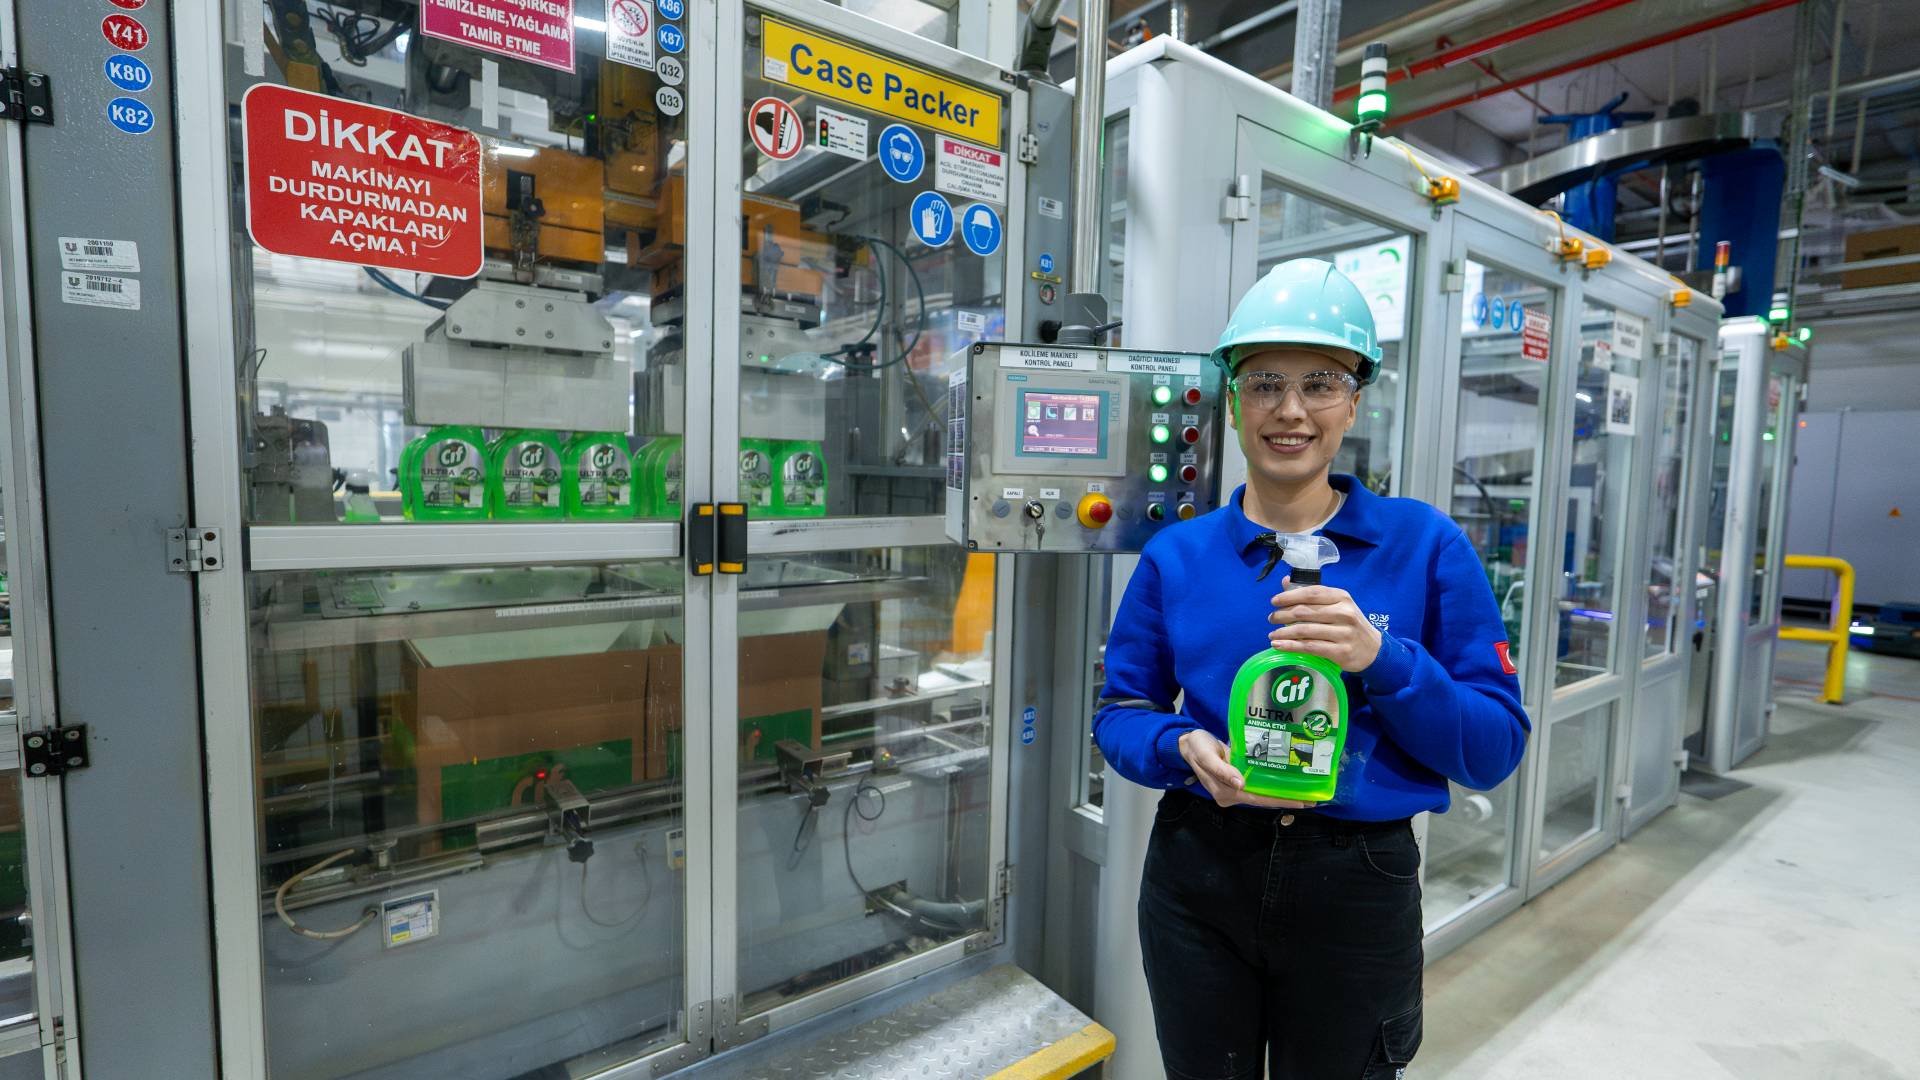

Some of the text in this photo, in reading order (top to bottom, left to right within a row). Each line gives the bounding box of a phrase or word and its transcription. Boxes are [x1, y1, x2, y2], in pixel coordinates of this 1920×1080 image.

[108, 20, 143, 45] Y41
[460, 22, 541, 55] TAMİR ETME
[660, 30, 680, 47] K87
[110, 62, 147, 83] K80
[660, 62, 680, 78] Q32
[790, 43, 980, 128] Case Packer
[660, 93, 679, 108] Q33
[112, 104, 149, 126] K82
[284, 108, 453, 168] DİKKAT
[953, 145, 992, 163] DİKKAT
[311, 160, 431, 197] MAKİNAYI
[269, 175, 467, 223] DURDURMADAN
[300, 203, 444, 241] KAPAKLARI
[329, 230, 417, 256] AÇMA !
[1020, 349, 1078, 359] KOLİLEME MAKİNESİ
[1024, 359, 1051, 367] KONTROL
[1128, 354, 1181, 364] DAĞITICI MAKİNESİ
[1130, 364, 1177, 373] KONTROL PANELİ
[440, 447, 464, 465] Cif
[521, 448, 543, 467] Cif
[594, 449, 615, 467] Cif
[741, 453, 758, 471] Cif
[796, 454, 812, 472] Cif
[422, 468, 456, 477] ULTRA
[504, 468, 536, 477] ULTRA
[579, 469, 608, 478] ULTRA
[1276, 676, 1310, 704] Cif
[1248, 706, 1294, 722] ULTRA
[1247, 719, 1271, 729] ANINDA
